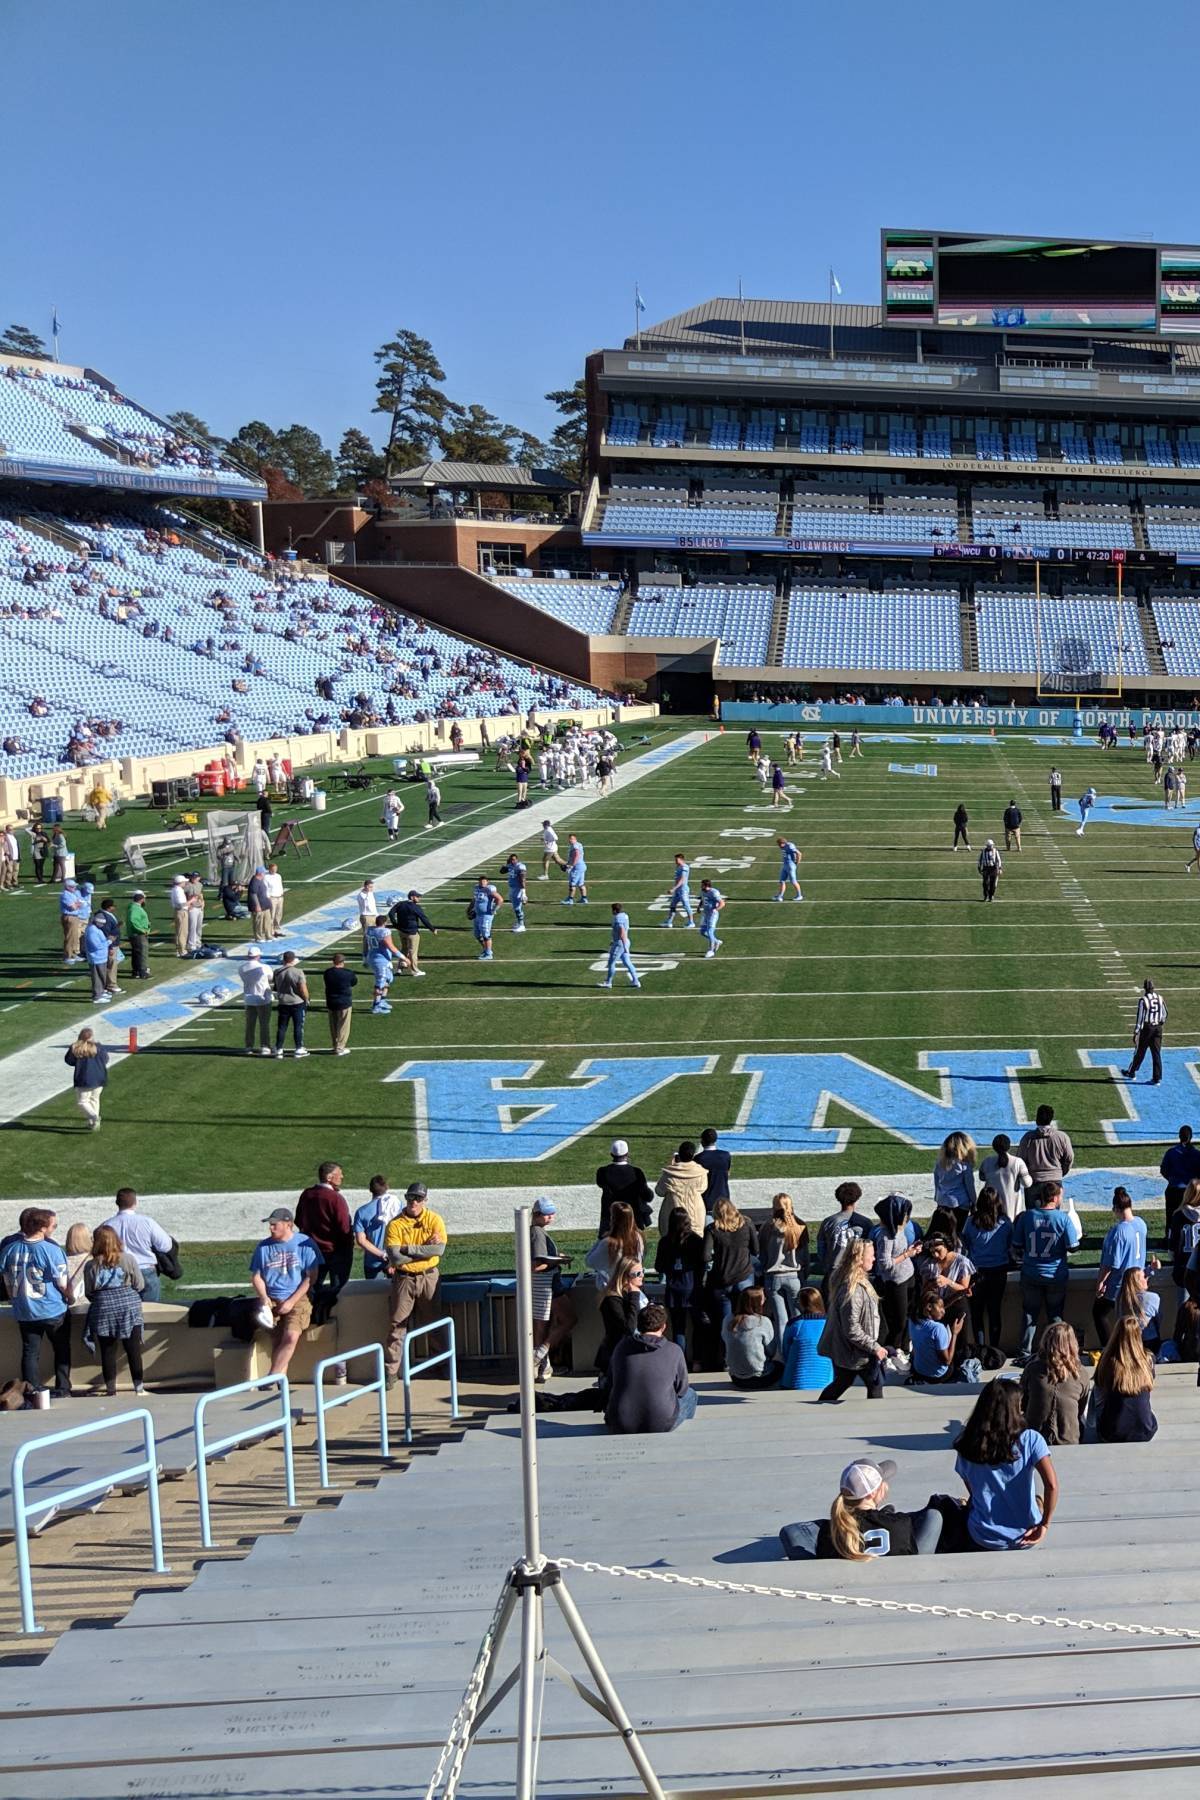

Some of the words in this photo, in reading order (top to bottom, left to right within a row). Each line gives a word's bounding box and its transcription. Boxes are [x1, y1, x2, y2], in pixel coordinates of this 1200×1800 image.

[1017, 465, 1056, 473] CENTER
[1092, 468, 1154, 476] EXCELLENCE
[96, 471, 137, 488] WELCOME
[140, 477, 150, 487] TO
[153, 480, 178, 492] KENAN
[182, 483, 218, 495] STADIUM
[679, 536, 693, 547] 85
[695, 537, 725, 548] LACEY
[787, 540, 801, 551] 20
[802, 541, 852, 552] LAWRENCE
[963, 547, 981, 556] WCU
[989, 546, 997, 557] 0
[1032, 549, 1050, 559] UNC
[1057, 549, 1065, 560] 0
[1086, 551, 1110, 561] 47:20
[1114, 553, 1124, 561] 40
[1042, 674, 1102, 692] Allstate
[913, 708, 1029, 725] UNIVERSITY
[1039, 711, 1059, 726] OF
[1028, 1232, 1057, 1258] 17
[1135, 1231, 1141, 1260] 1
